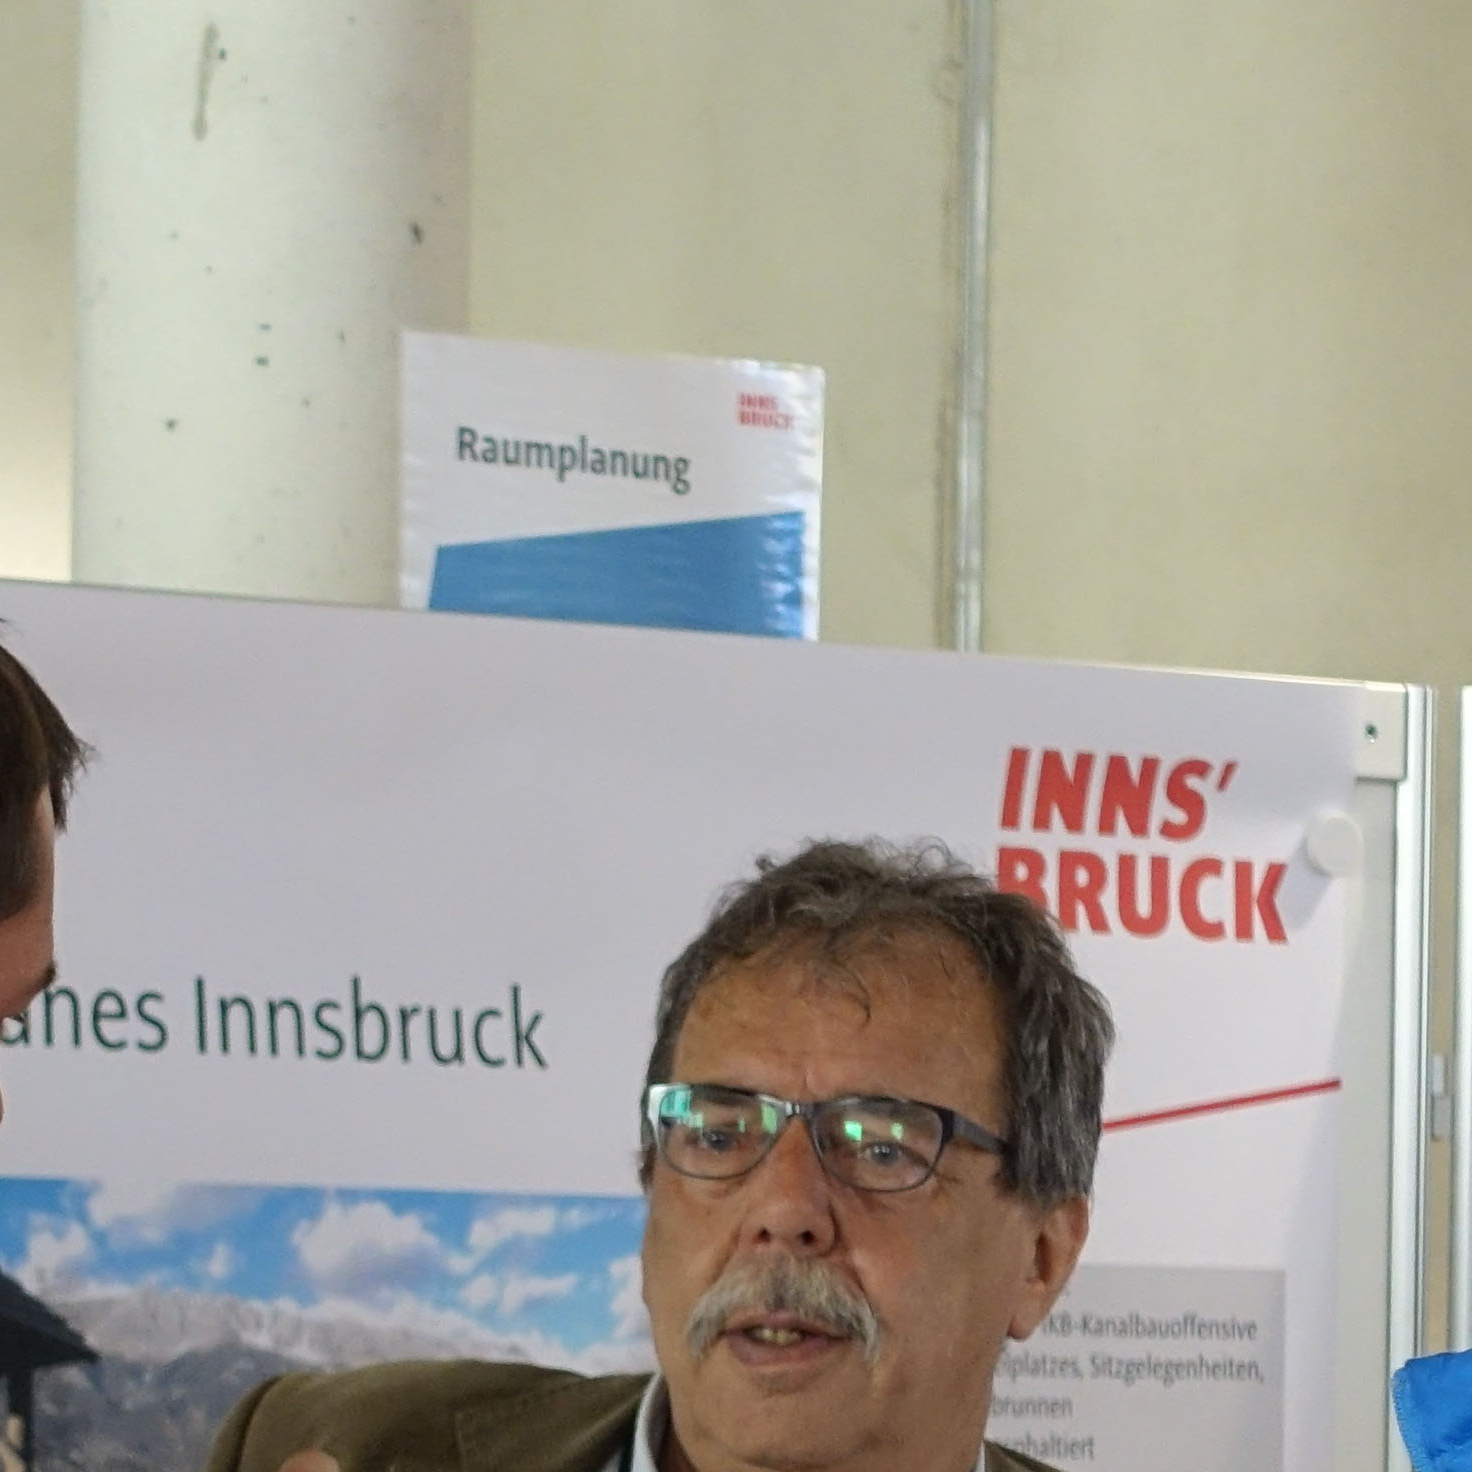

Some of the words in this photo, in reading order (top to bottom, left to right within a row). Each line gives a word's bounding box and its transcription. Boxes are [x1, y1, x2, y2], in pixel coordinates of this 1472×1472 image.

[457, 425, 691, 494] Raumplanung
[999, 747, 1239, 842] INNS'
[996, 846, 1289, 945] BRUCK
[195, 974, 548, 1070] Innsbruck
